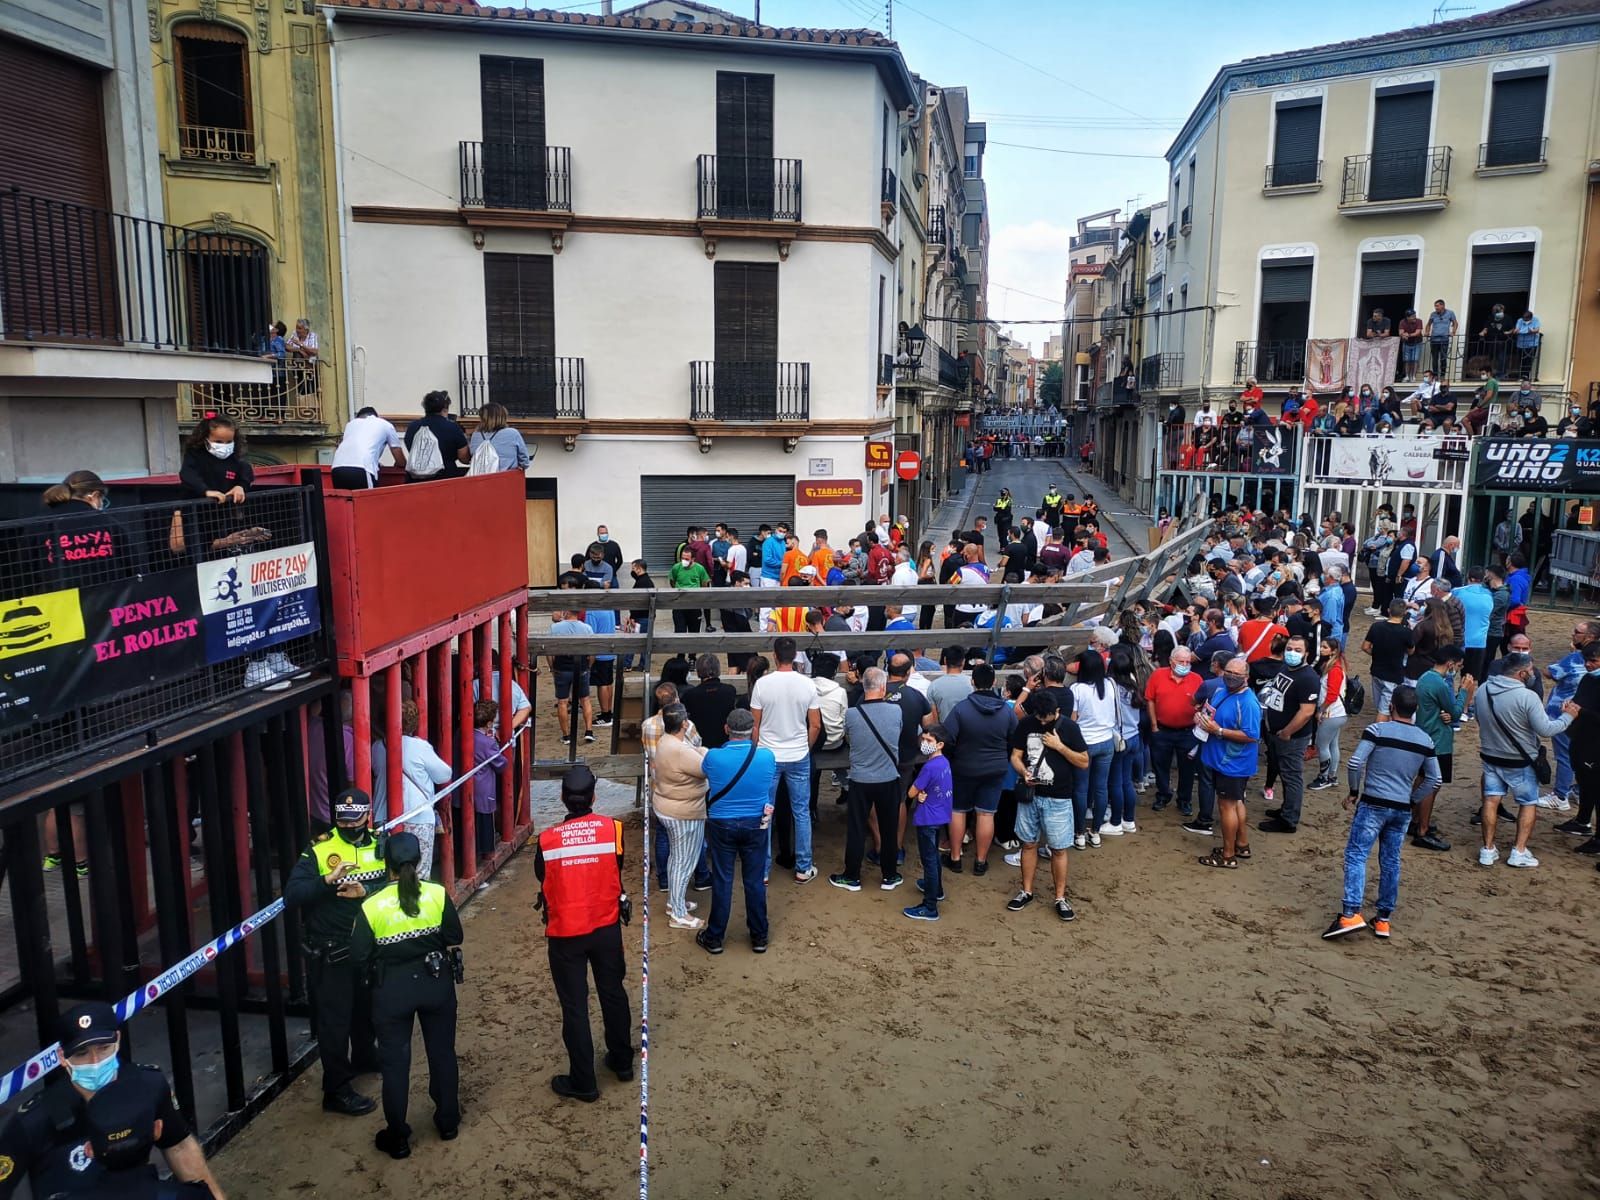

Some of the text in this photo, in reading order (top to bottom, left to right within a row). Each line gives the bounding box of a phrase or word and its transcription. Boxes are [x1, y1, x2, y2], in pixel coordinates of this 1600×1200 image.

[1486, 443, 1570, 462] UNO2
[1498, 461, 1564, 480] UNO
[816, 487, 854, 496] TABACOS
[250, 553, 307, 584] URGE 24H
[251, 573, 307, 597] MULTISERVICIOS
[109, 595, 178, 627] PENYA
[93, 618, 199, 664] EL ROLLET
[553, 820, 589, 833] PROTECCIÓN
[561, 828, 596, 838] DIPUTACIÓN
[562, 835, 596, 846] CASTELLÓN
[561, 857, 600, 867] ENFERMERO
[157, 969, 179, 992] LOCAL
[107, 1128, 133, 1141] CNP
